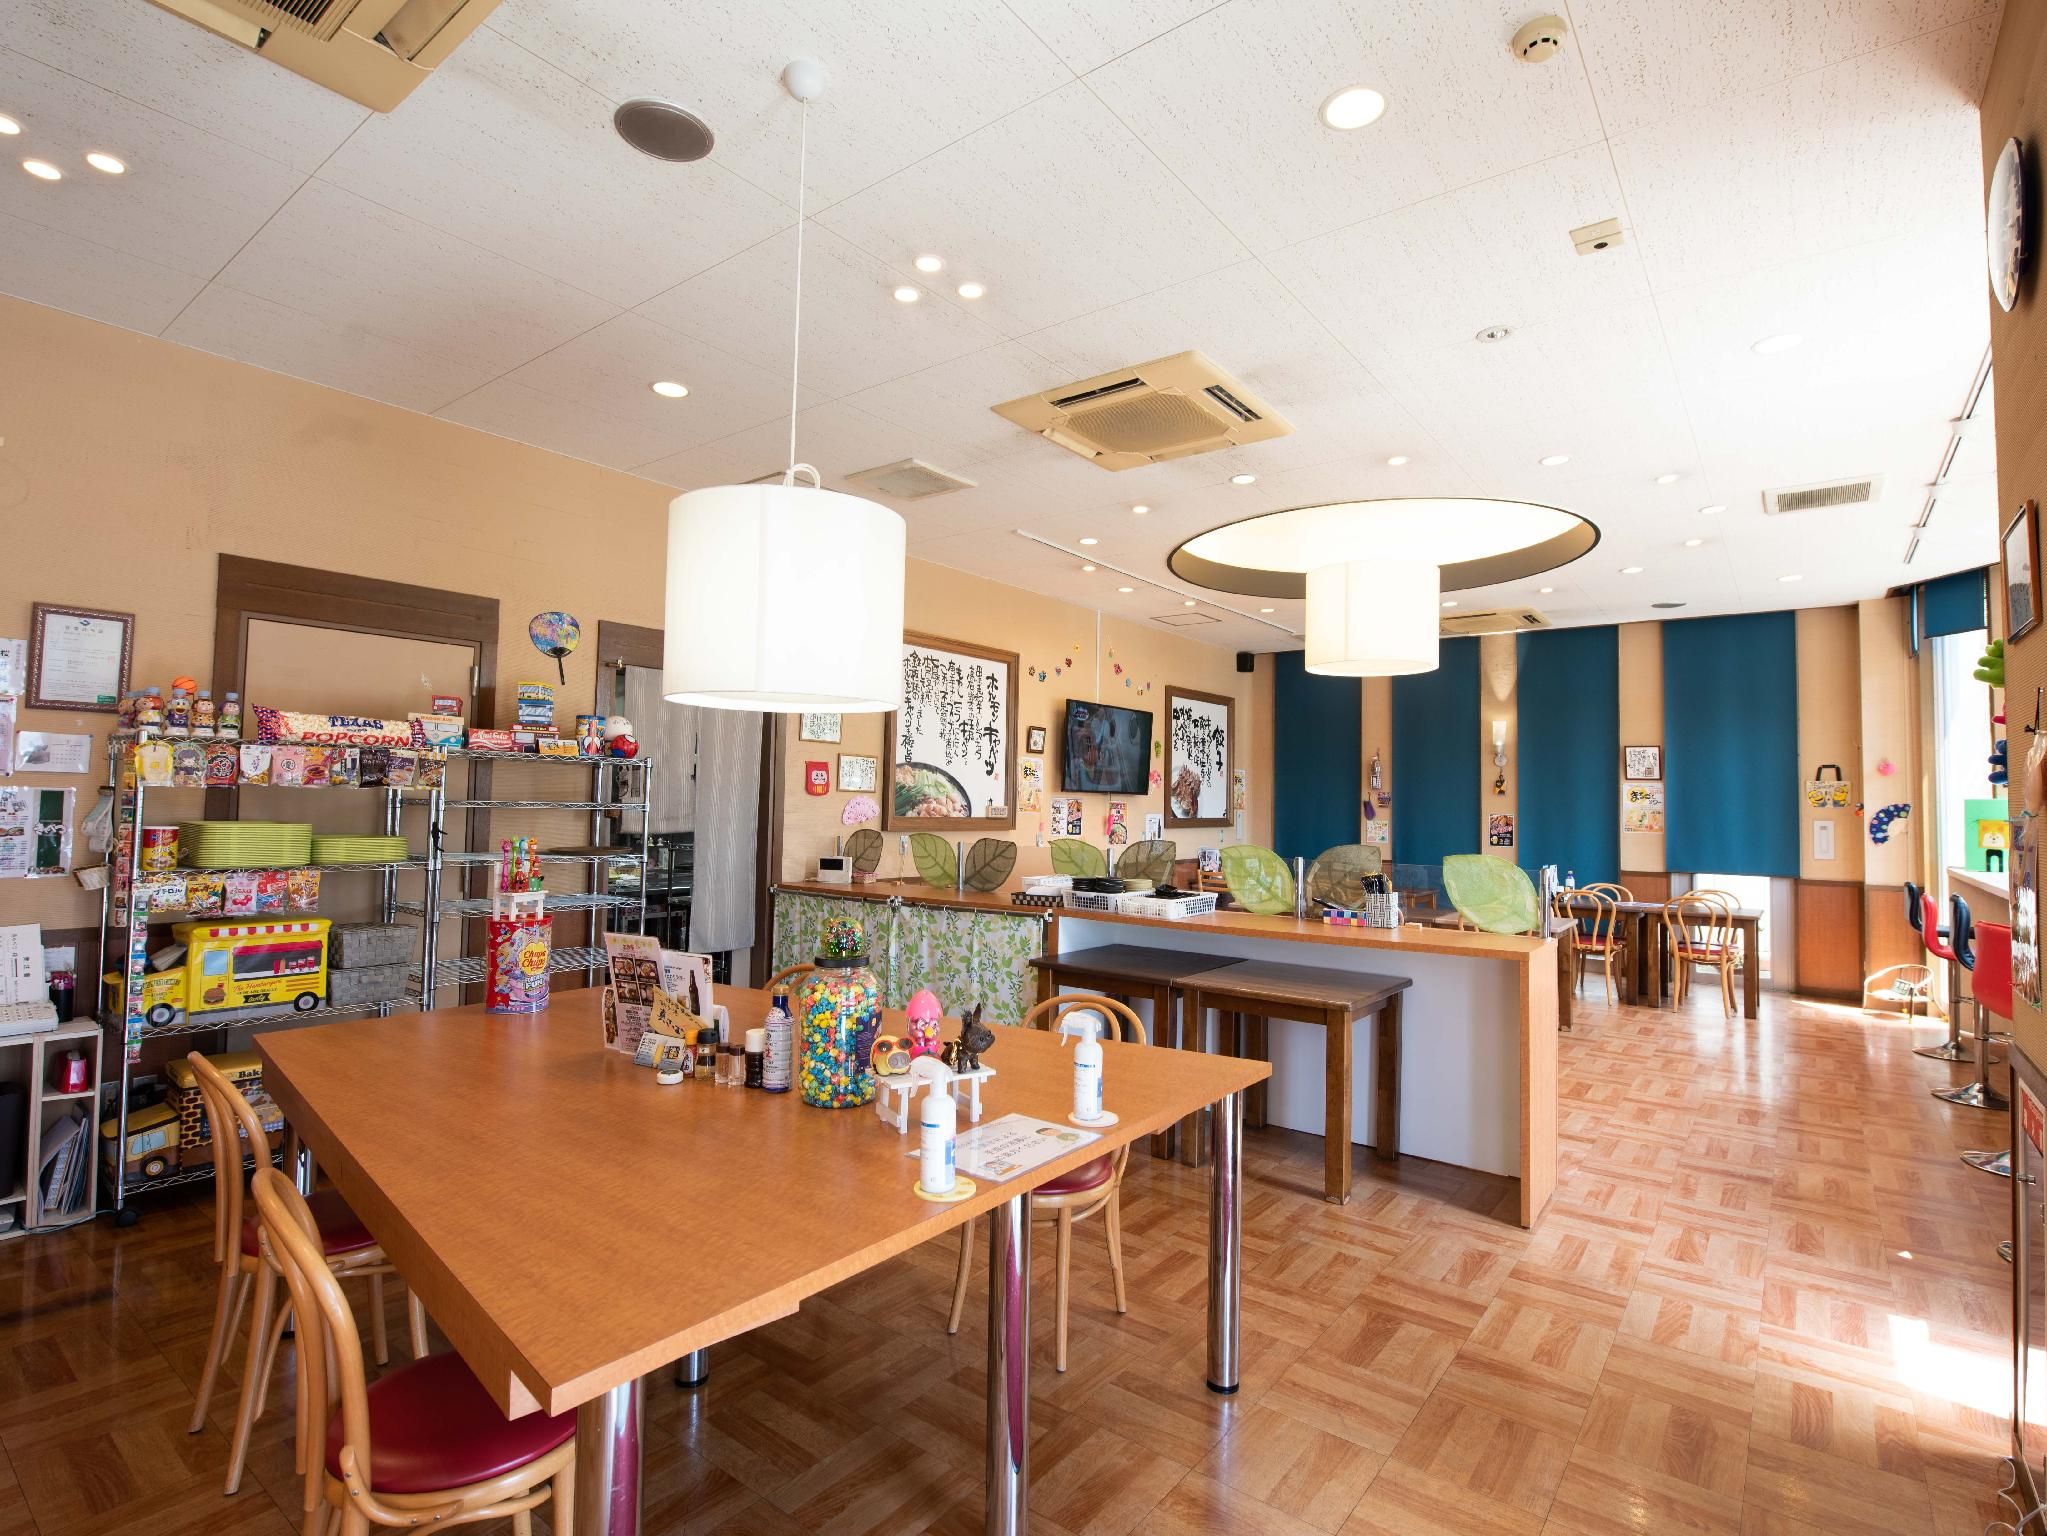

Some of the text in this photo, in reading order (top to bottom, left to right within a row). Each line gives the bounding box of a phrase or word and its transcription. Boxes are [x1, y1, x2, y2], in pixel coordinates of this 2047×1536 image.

[328, 715, 384, 730] TEXAS
[983, 672, 1002, 776] ホルモンキャベツ
[300, 731, 411, 748] POPCORN
[1211, 724, 1225, 772] 餃子
[1630, 790, 1657, 803] まるごと
[238, 1070, 262, 1078] Bak
